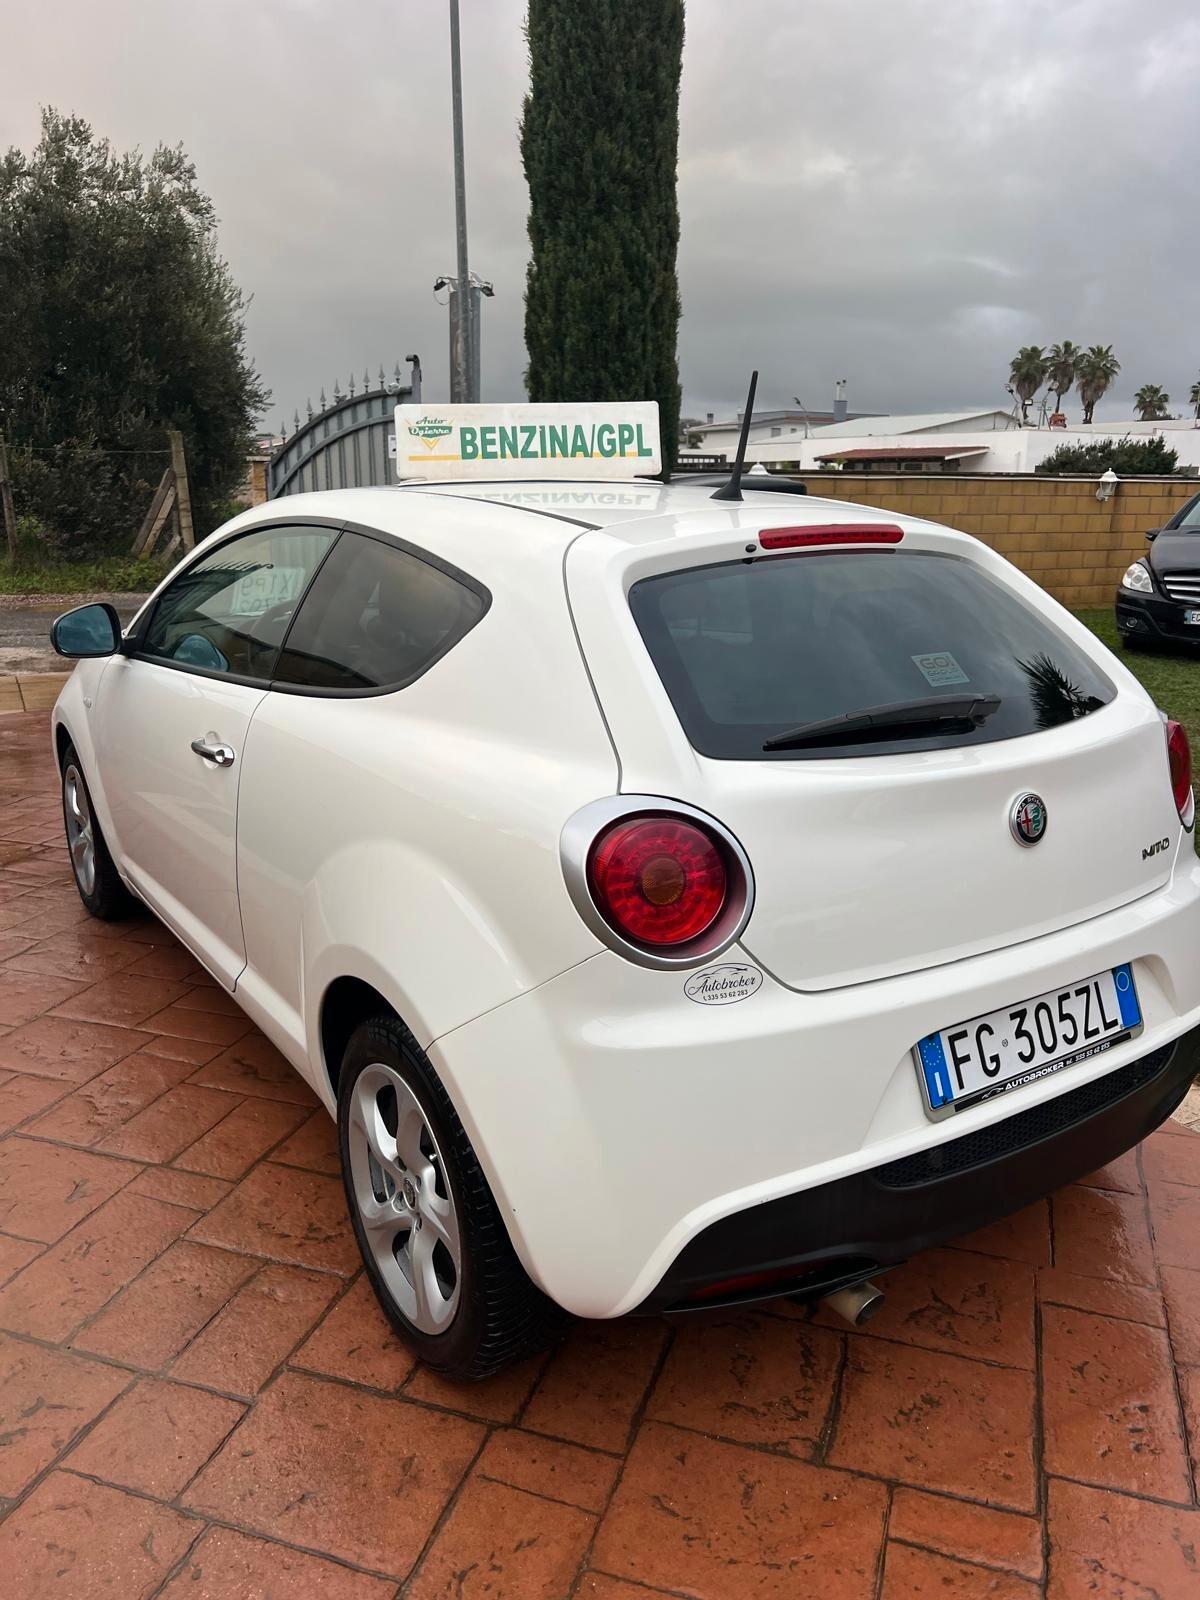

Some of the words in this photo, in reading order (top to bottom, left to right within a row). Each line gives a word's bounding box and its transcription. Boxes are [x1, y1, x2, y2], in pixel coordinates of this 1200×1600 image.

[416, 416, 447, 424] Auto
[460, 424, 652, 460] BENZINA/GPL
[687, 975, 755, 996] Autobroker
[708, 993, 719, 1001] 335
[737, 989, 749, 997] 283
[948, 1023, 1001, 1091] FG
[1009, 980, 1119, 1064] 305ZL
[1005, 1061, 1064, 1090] AUTOBROKER
